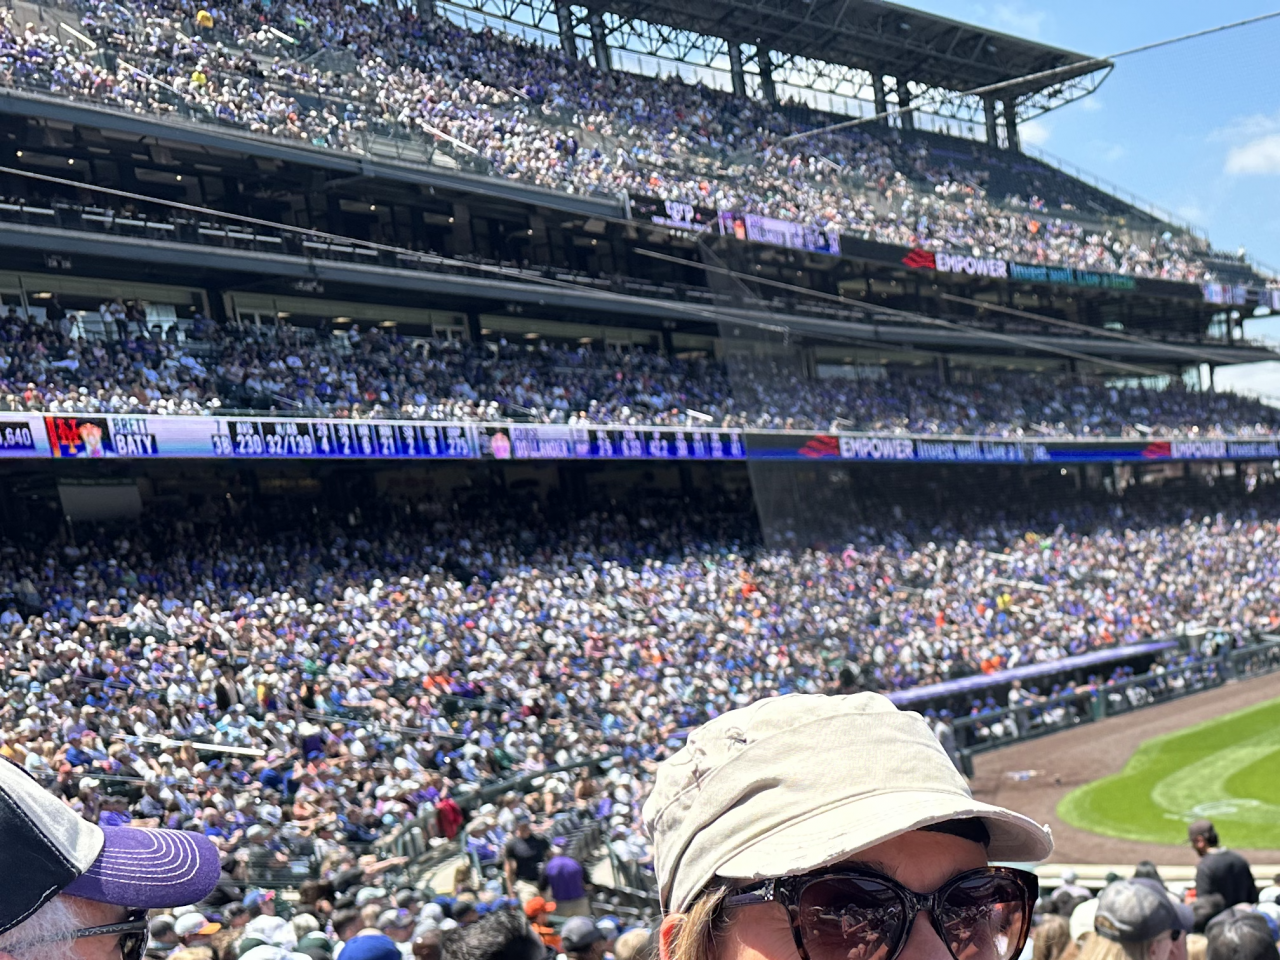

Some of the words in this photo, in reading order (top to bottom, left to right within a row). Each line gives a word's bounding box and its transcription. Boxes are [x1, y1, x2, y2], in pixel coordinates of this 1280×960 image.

[936, 253, 1007, 278] EMPOWER
[112, 418, 148, 433] BRETT
[0, 427, 31, 448] ,640
[115, 434, 153, 455] BATY
[236, 435, 262, 454] .230
[266, 434, 312, 455] 32/139
[840, 437, 914, 458] EMPOWER
